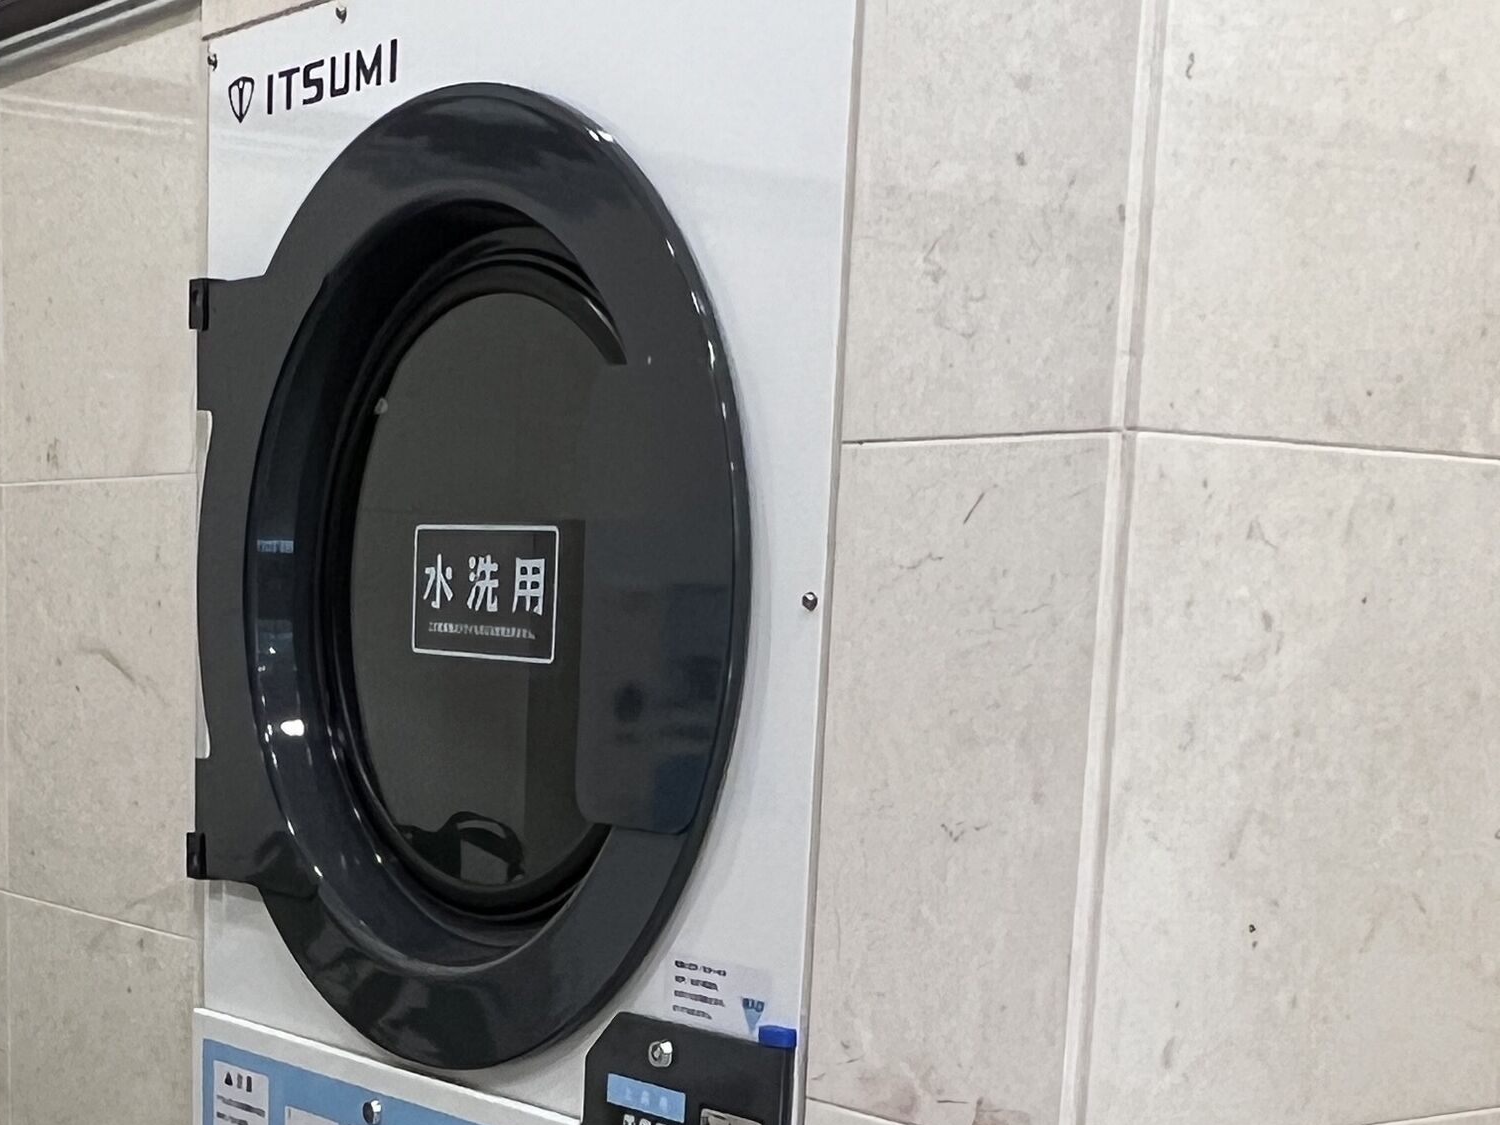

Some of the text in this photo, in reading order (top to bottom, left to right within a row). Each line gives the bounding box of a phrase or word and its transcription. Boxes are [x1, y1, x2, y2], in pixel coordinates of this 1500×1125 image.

[267, 38, 398, 115] ITSUMI
[423, 553, 546, 616] 水洗用
